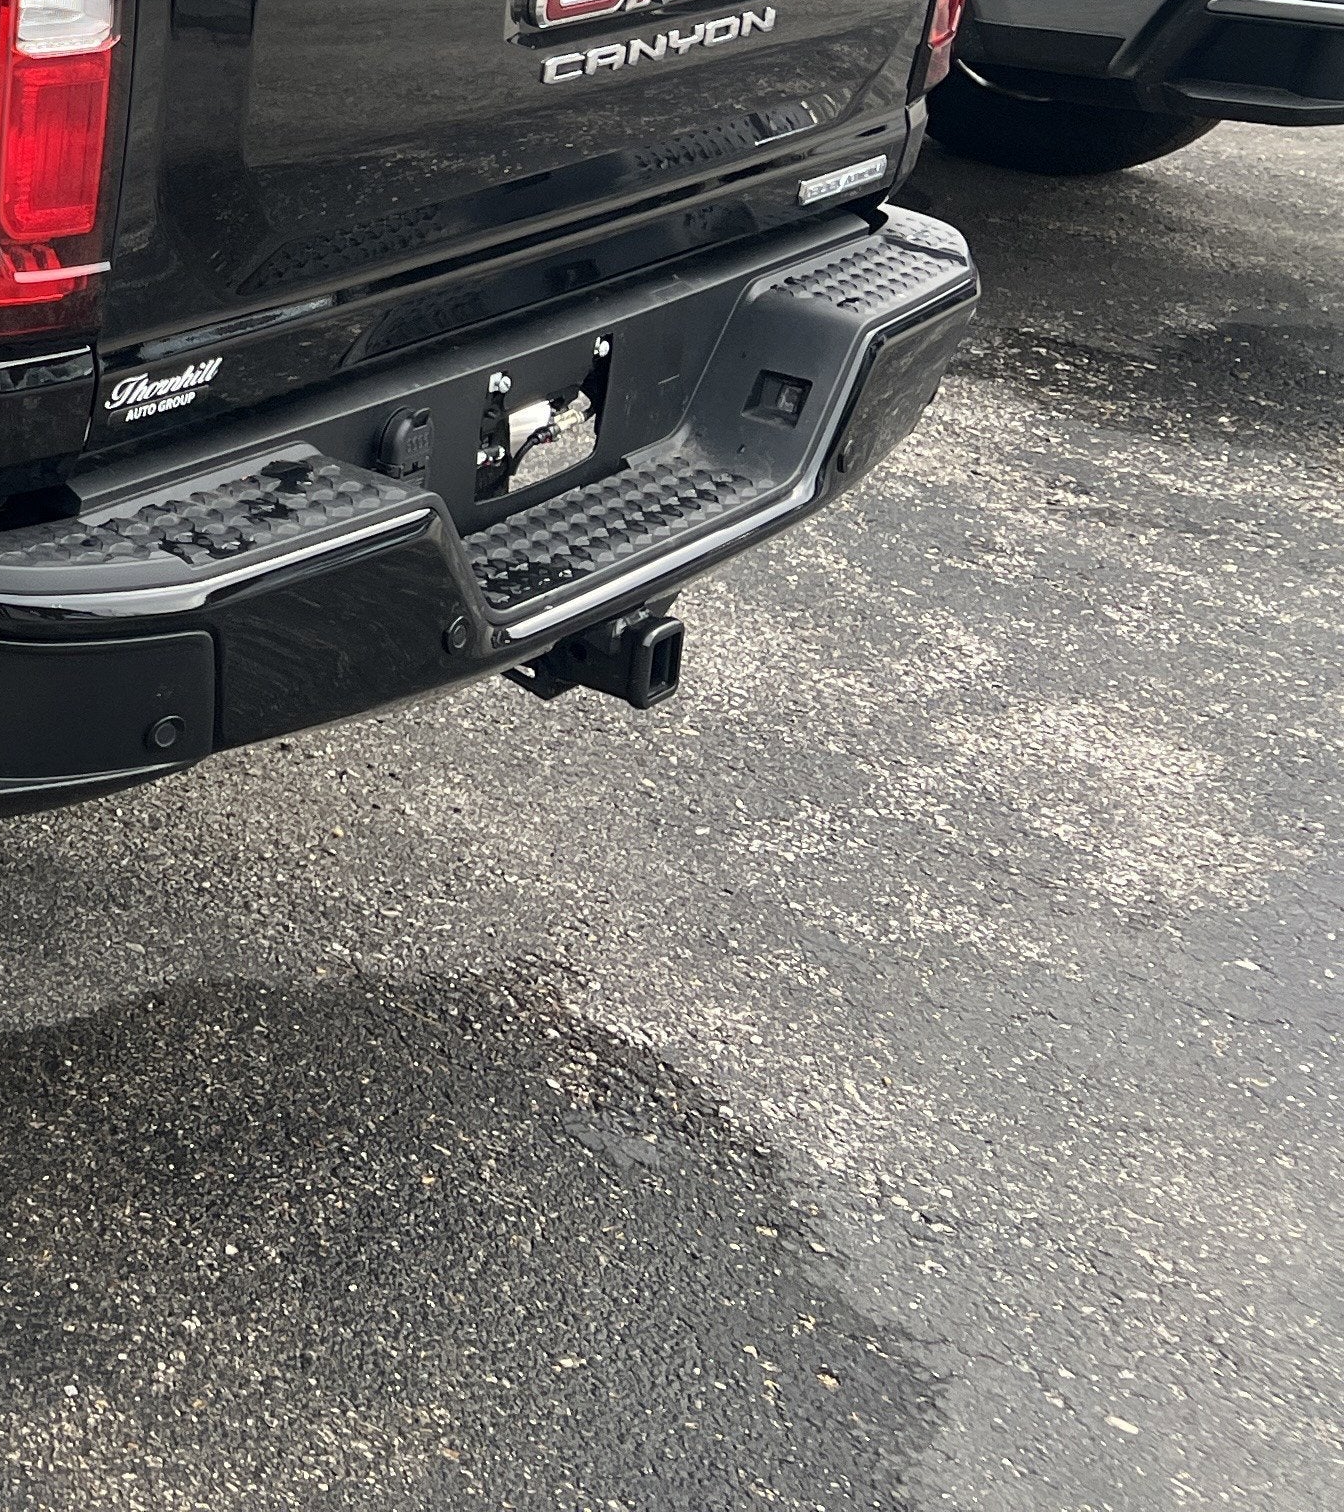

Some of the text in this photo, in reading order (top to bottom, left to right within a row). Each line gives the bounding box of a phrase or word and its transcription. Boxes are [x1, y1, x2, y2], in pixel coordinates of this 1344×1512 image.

[541, 6, 776, 84] CANYON
[104, 357, 223, 410] Thornhill
[125, 391, 196, 422] AUTO GROUP
